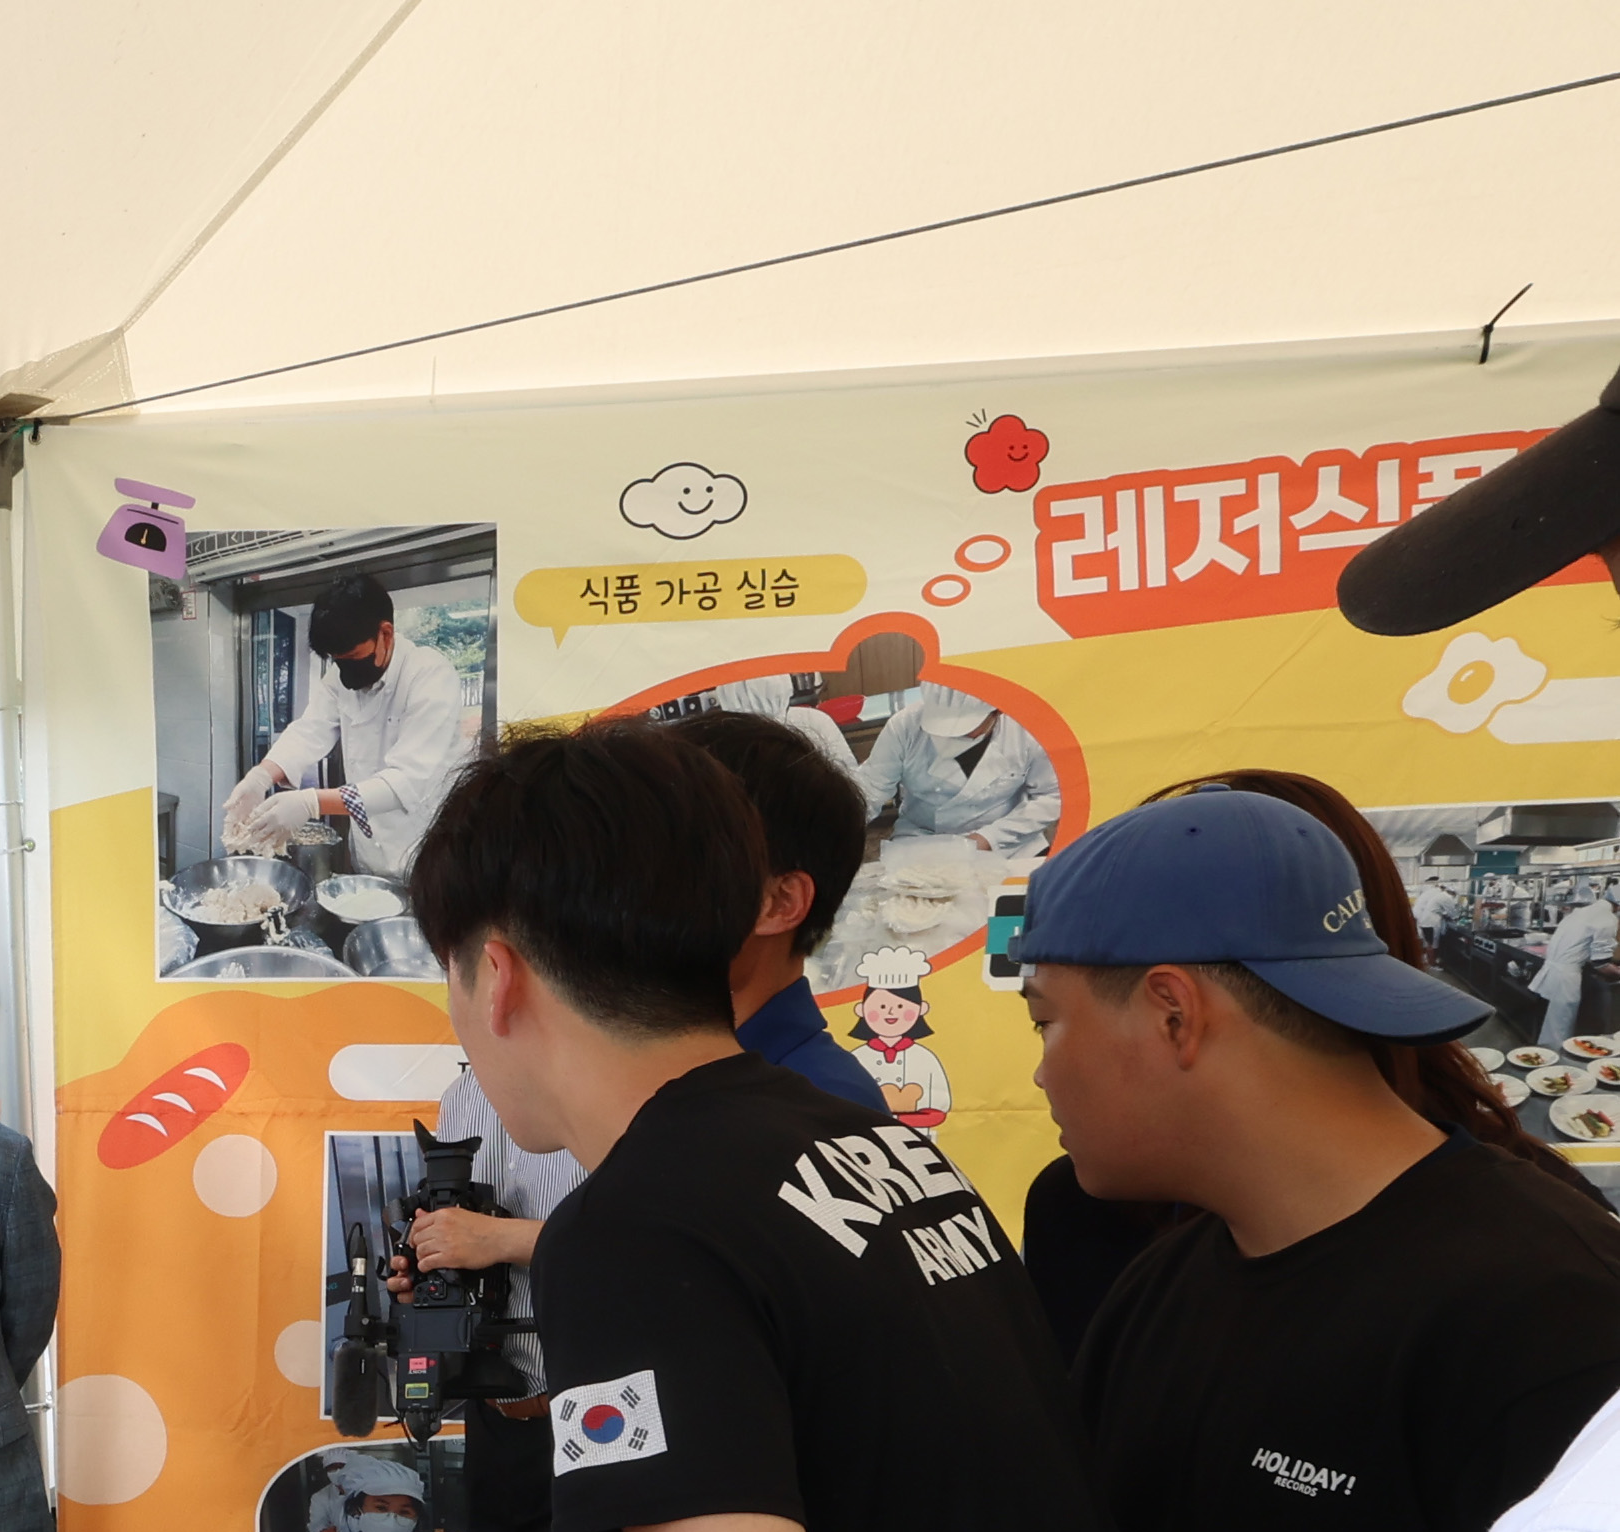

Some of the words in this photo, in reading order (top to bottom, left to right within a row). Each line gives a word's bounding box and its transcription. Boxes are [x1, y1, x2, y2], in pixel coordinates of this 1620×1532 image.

[579, 573, 640, 614] 식품
[655, 571, 723, 611] 가공
[735, 567, 801, 609] 실습
[777, 1125, 977, 1258] KORE
[901, 1206, 1002, 1286] ARMY
[1251, 1448, 1356, 1496] HOLIDAY!
[1274, 1476, 1319, 1497] RECORDS
